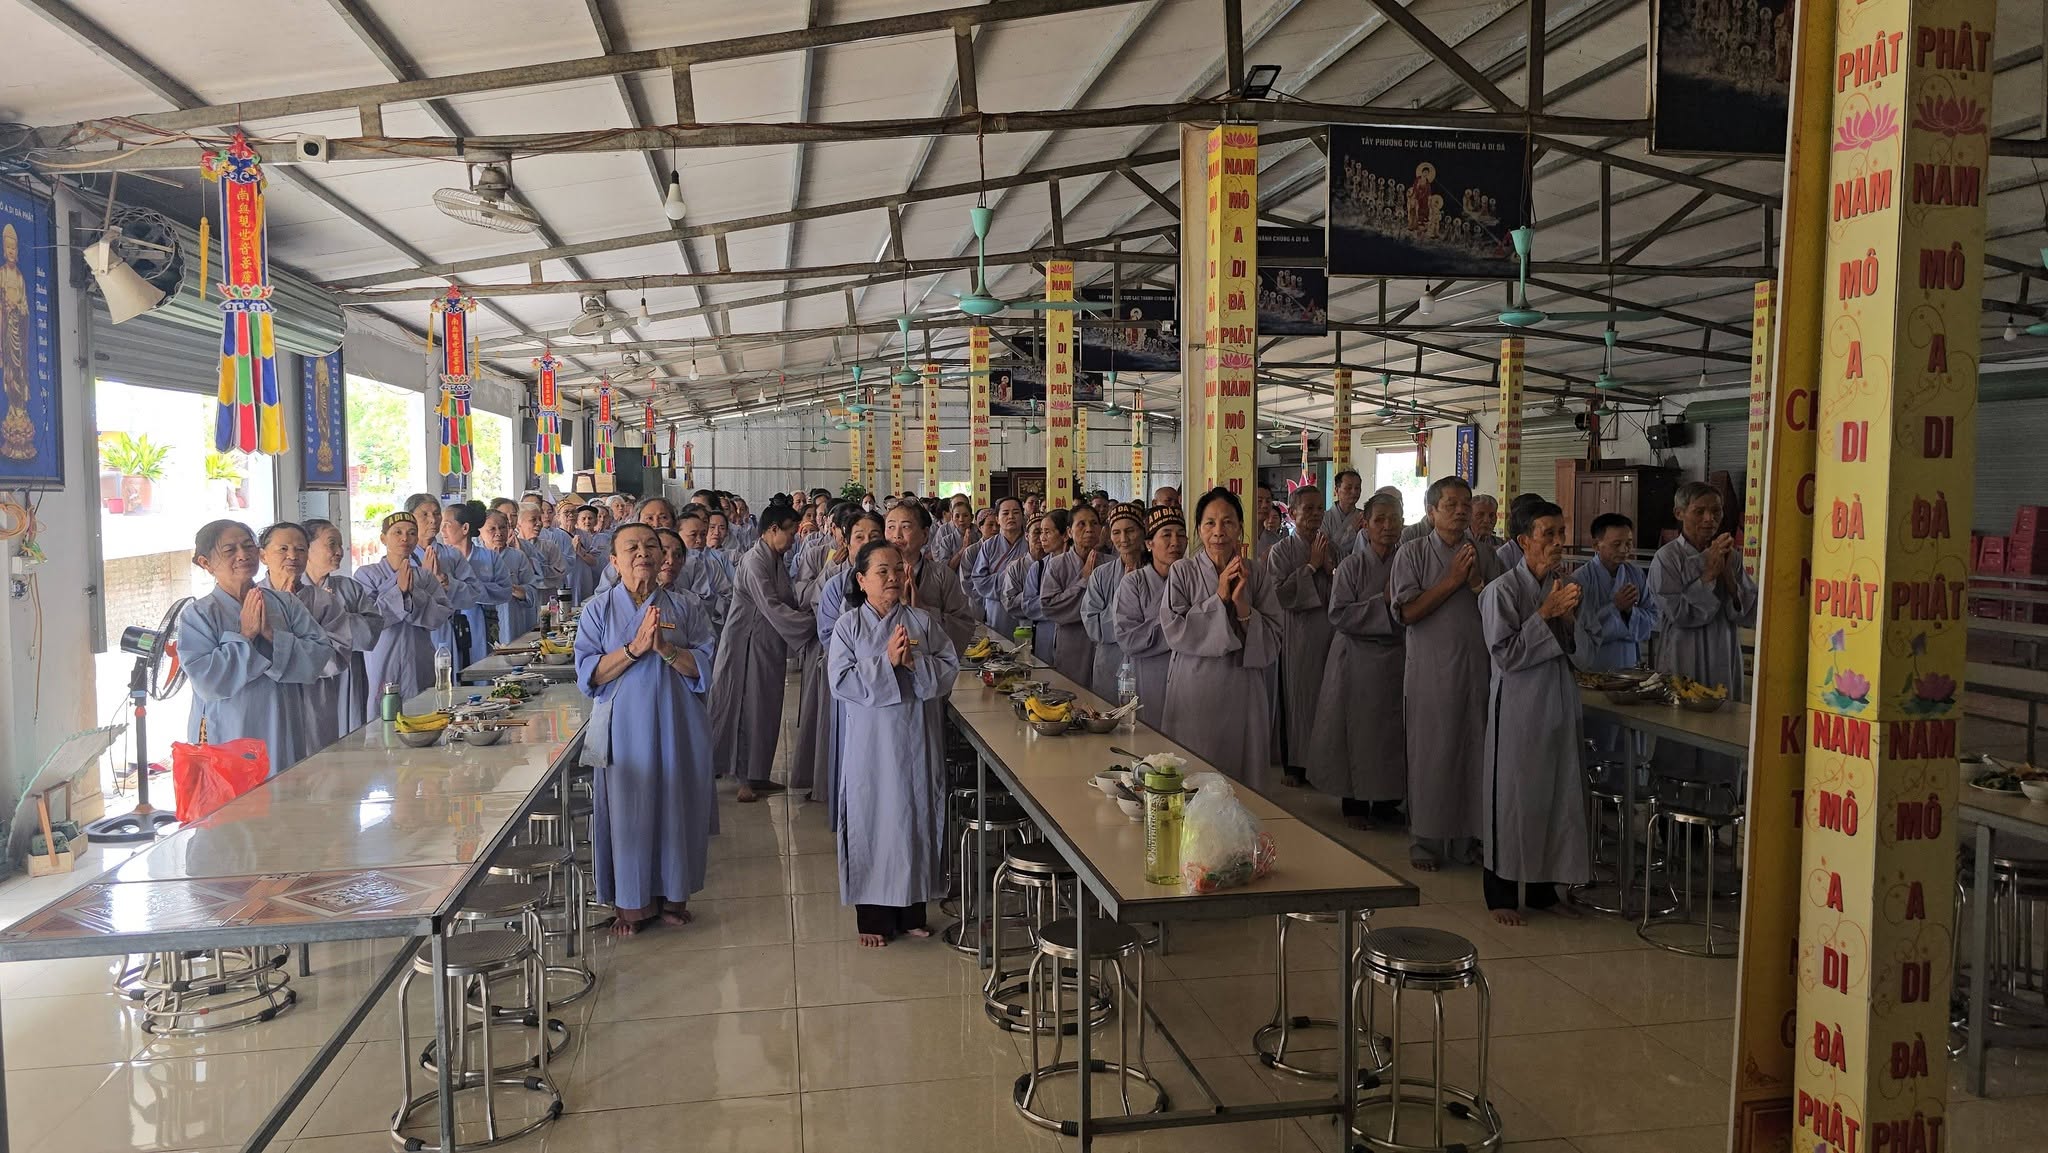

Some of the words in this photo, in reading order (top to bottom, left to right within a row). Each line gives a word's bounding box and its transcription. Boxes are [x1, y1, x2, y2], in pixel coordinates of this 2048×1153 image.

[1838, 30, 1903, 93] PHẬT
[1916, 22, 1991, 80] PHẬT
[1225, 159, 1255, 175] NAM
[1913, 164, 1980, 206] NAM
[1228, 190, 1249, 209] MÔ
[1834, 169, 1892, 222] NAM
[1234, 227, 1242, 242] A
[1052, 281, 1071, 290] NAM
[1233, 260, 1246, 277] DI
[1839, 248, 1878, 300] MÔ
[1920, 242, 1965, 290] MÔ
[1228, 291, 1246, 310] ĐÀ
[1059, 323, 1064, 332] A
[1221, 325, 1253, 348] PHẬT
[1059, 343, 1066, 353] DI
[1846, 341, 1862, 379] A
[1928, 334, 1947, 373] A
[1051, 383, 1071, 394] PHẬT
[1221, 381, 1250, 396] NAM
[1052, 417, 1071, 427] NAM
[1225, 410, 1245, 430] MÔ
[1924, 416, 1953, 458] DI
[1055, 435, 1068, 447] MÔ
[1230, 447, 1238, 461] A
[1842, 421, 1868, 462] DI
[1058, 458, 1064, 467] A
[1059, 478, 1066, 488] DI
[1832, 495, 1864, 540] ĐÀ
[1911, 492, 1950, 539] ĐÀ
[1815, 574, 1878, 628] PHẬT
[1891, 575, 1964, 628] PHẬT
[1814, 710, 1870, 759] NAM
[1889, 720, 1955, 760] NAM
[1819, 790, 1858, 836] MÔ
[1896, 793, 1941, 840] MÔ
[1827, 872, 1843, 912] A
[1906, 882, 1925, 920] A
[1823, 946, 1848, 994] DI
[1902, 962, 1930, 1003] DI
[1814, 1022, 1846, 1072] ĐÀ
[1891, 1034, 1928, 1079] ĐÀ
